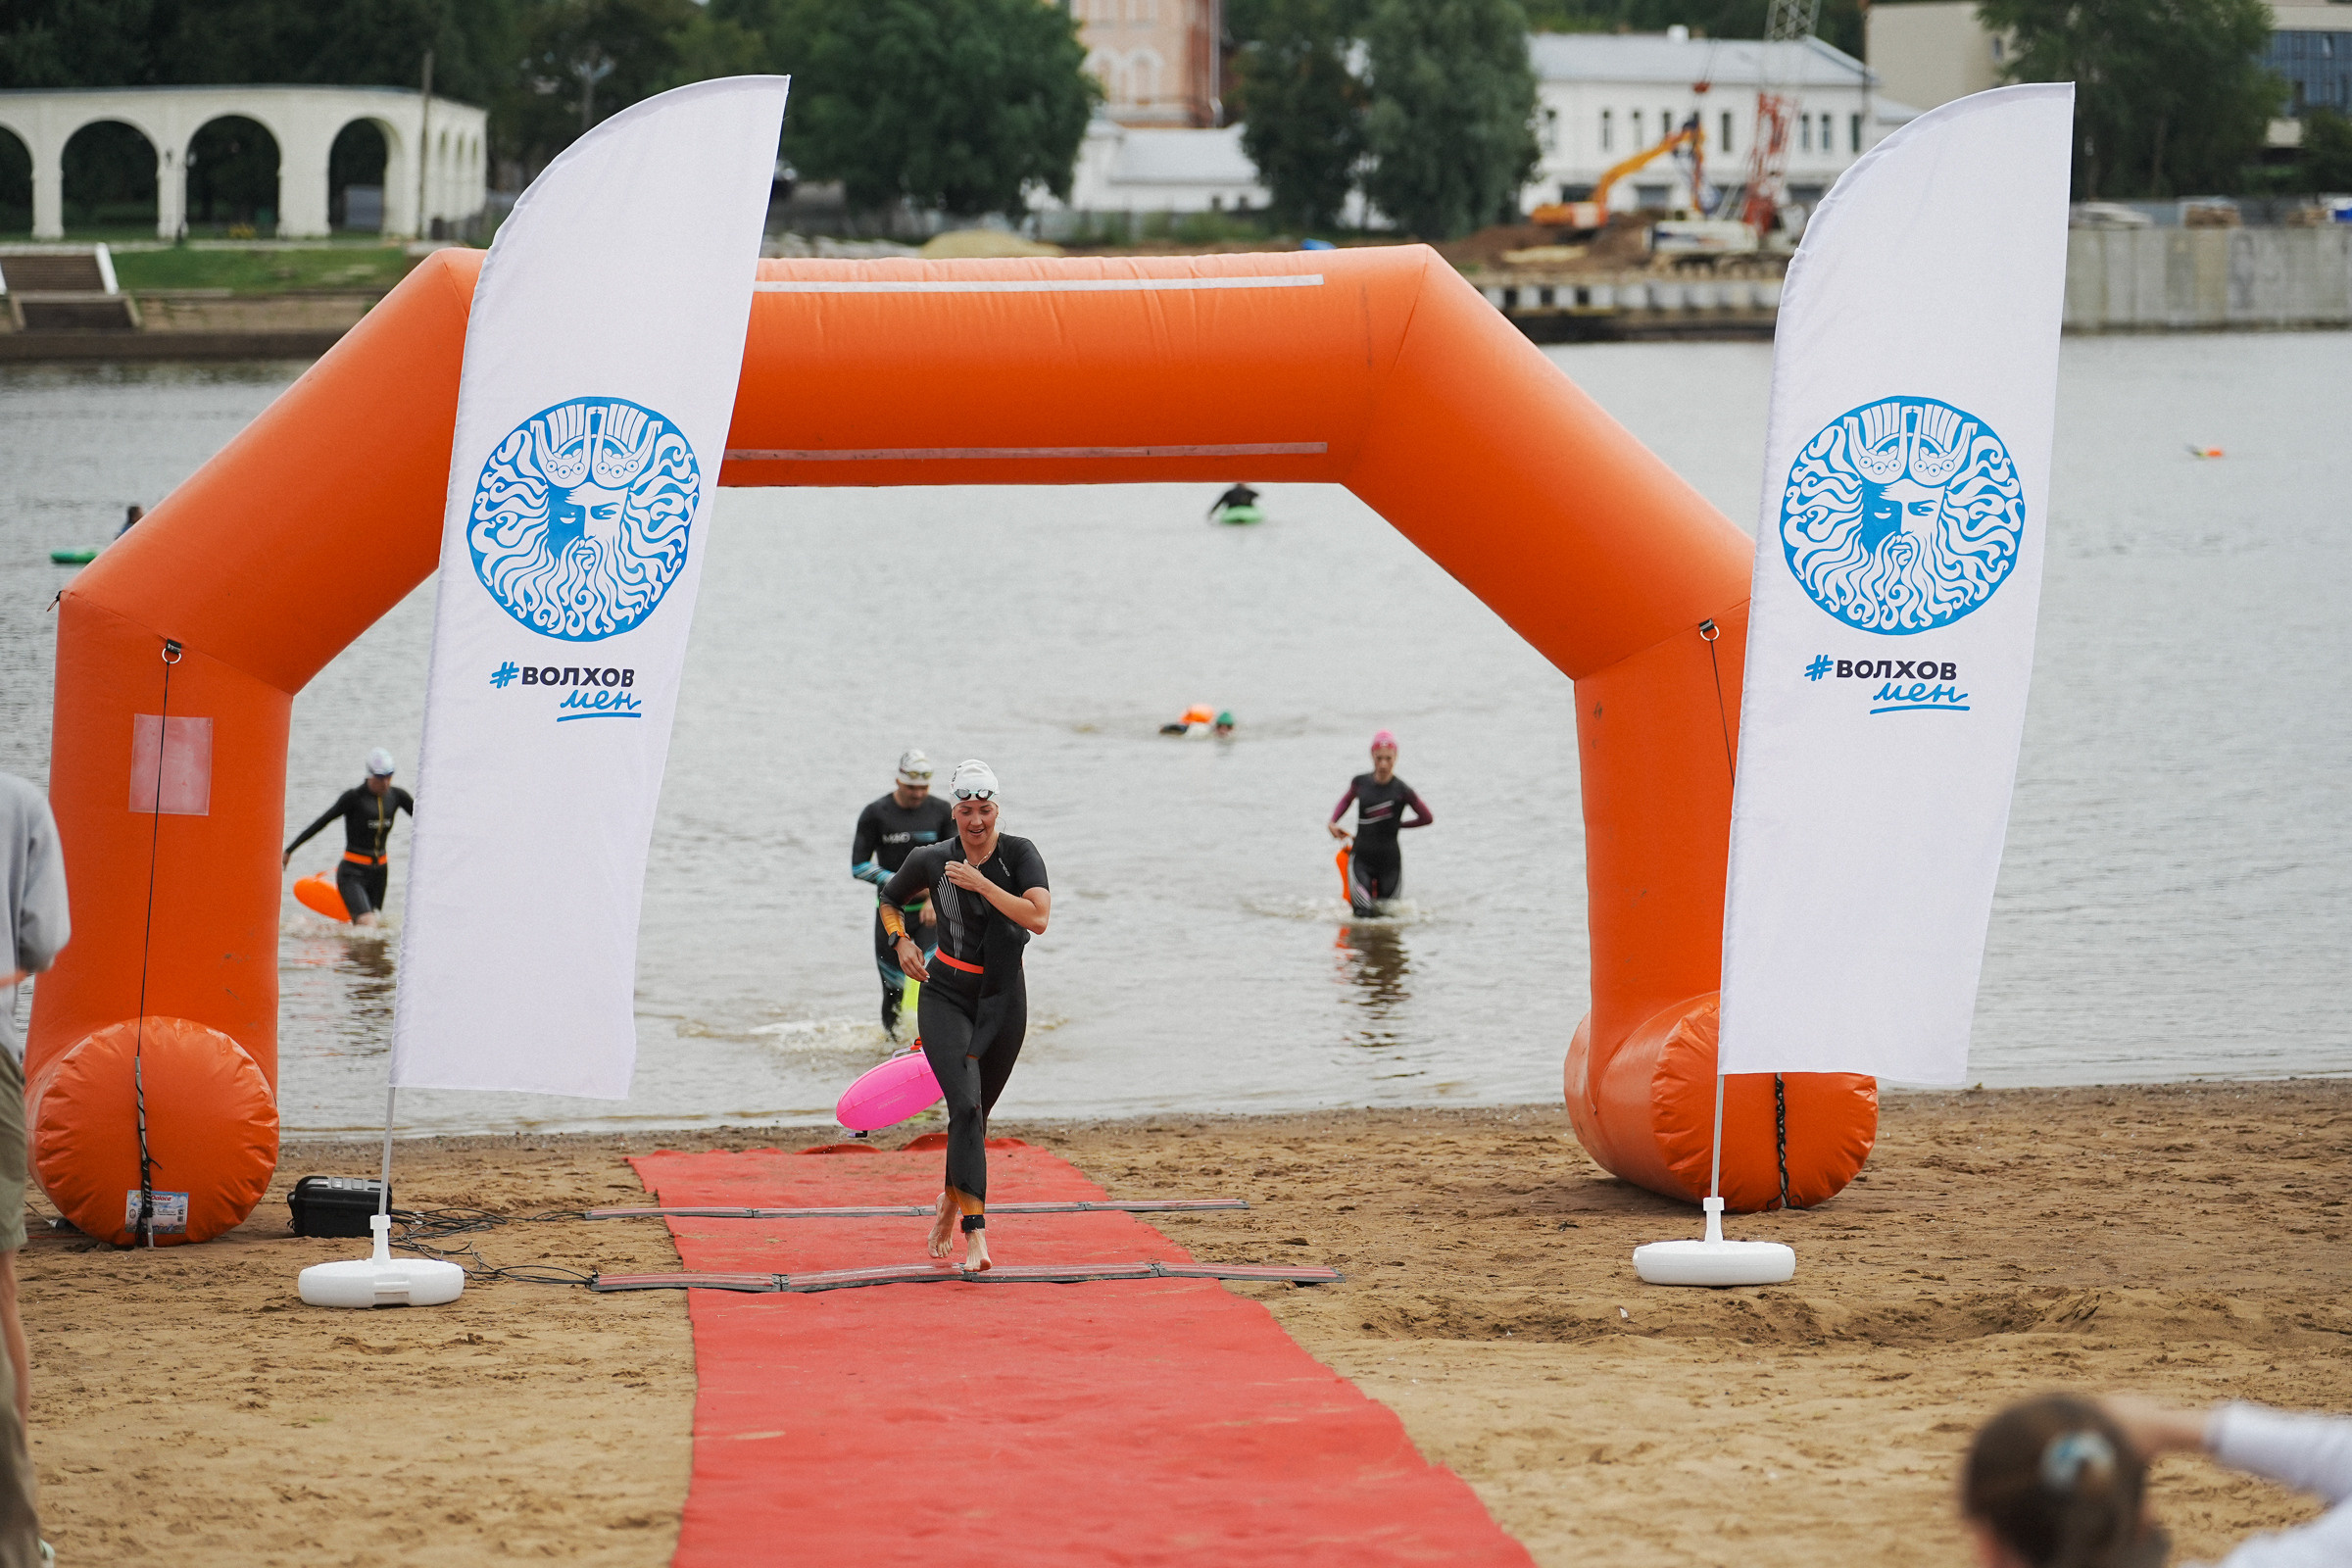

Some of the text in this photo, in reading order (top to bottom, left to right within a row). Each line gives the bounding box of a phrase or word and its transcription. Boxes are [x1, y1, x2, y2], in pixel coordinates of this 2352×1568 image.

[489, 661, 635, 689] #ВОЛХОВ
[1803, 654, 1957, 681] #ВОЛХОВ
[560, 689, 642, 710] мен
[1873, 682, 1969, 703] мен
